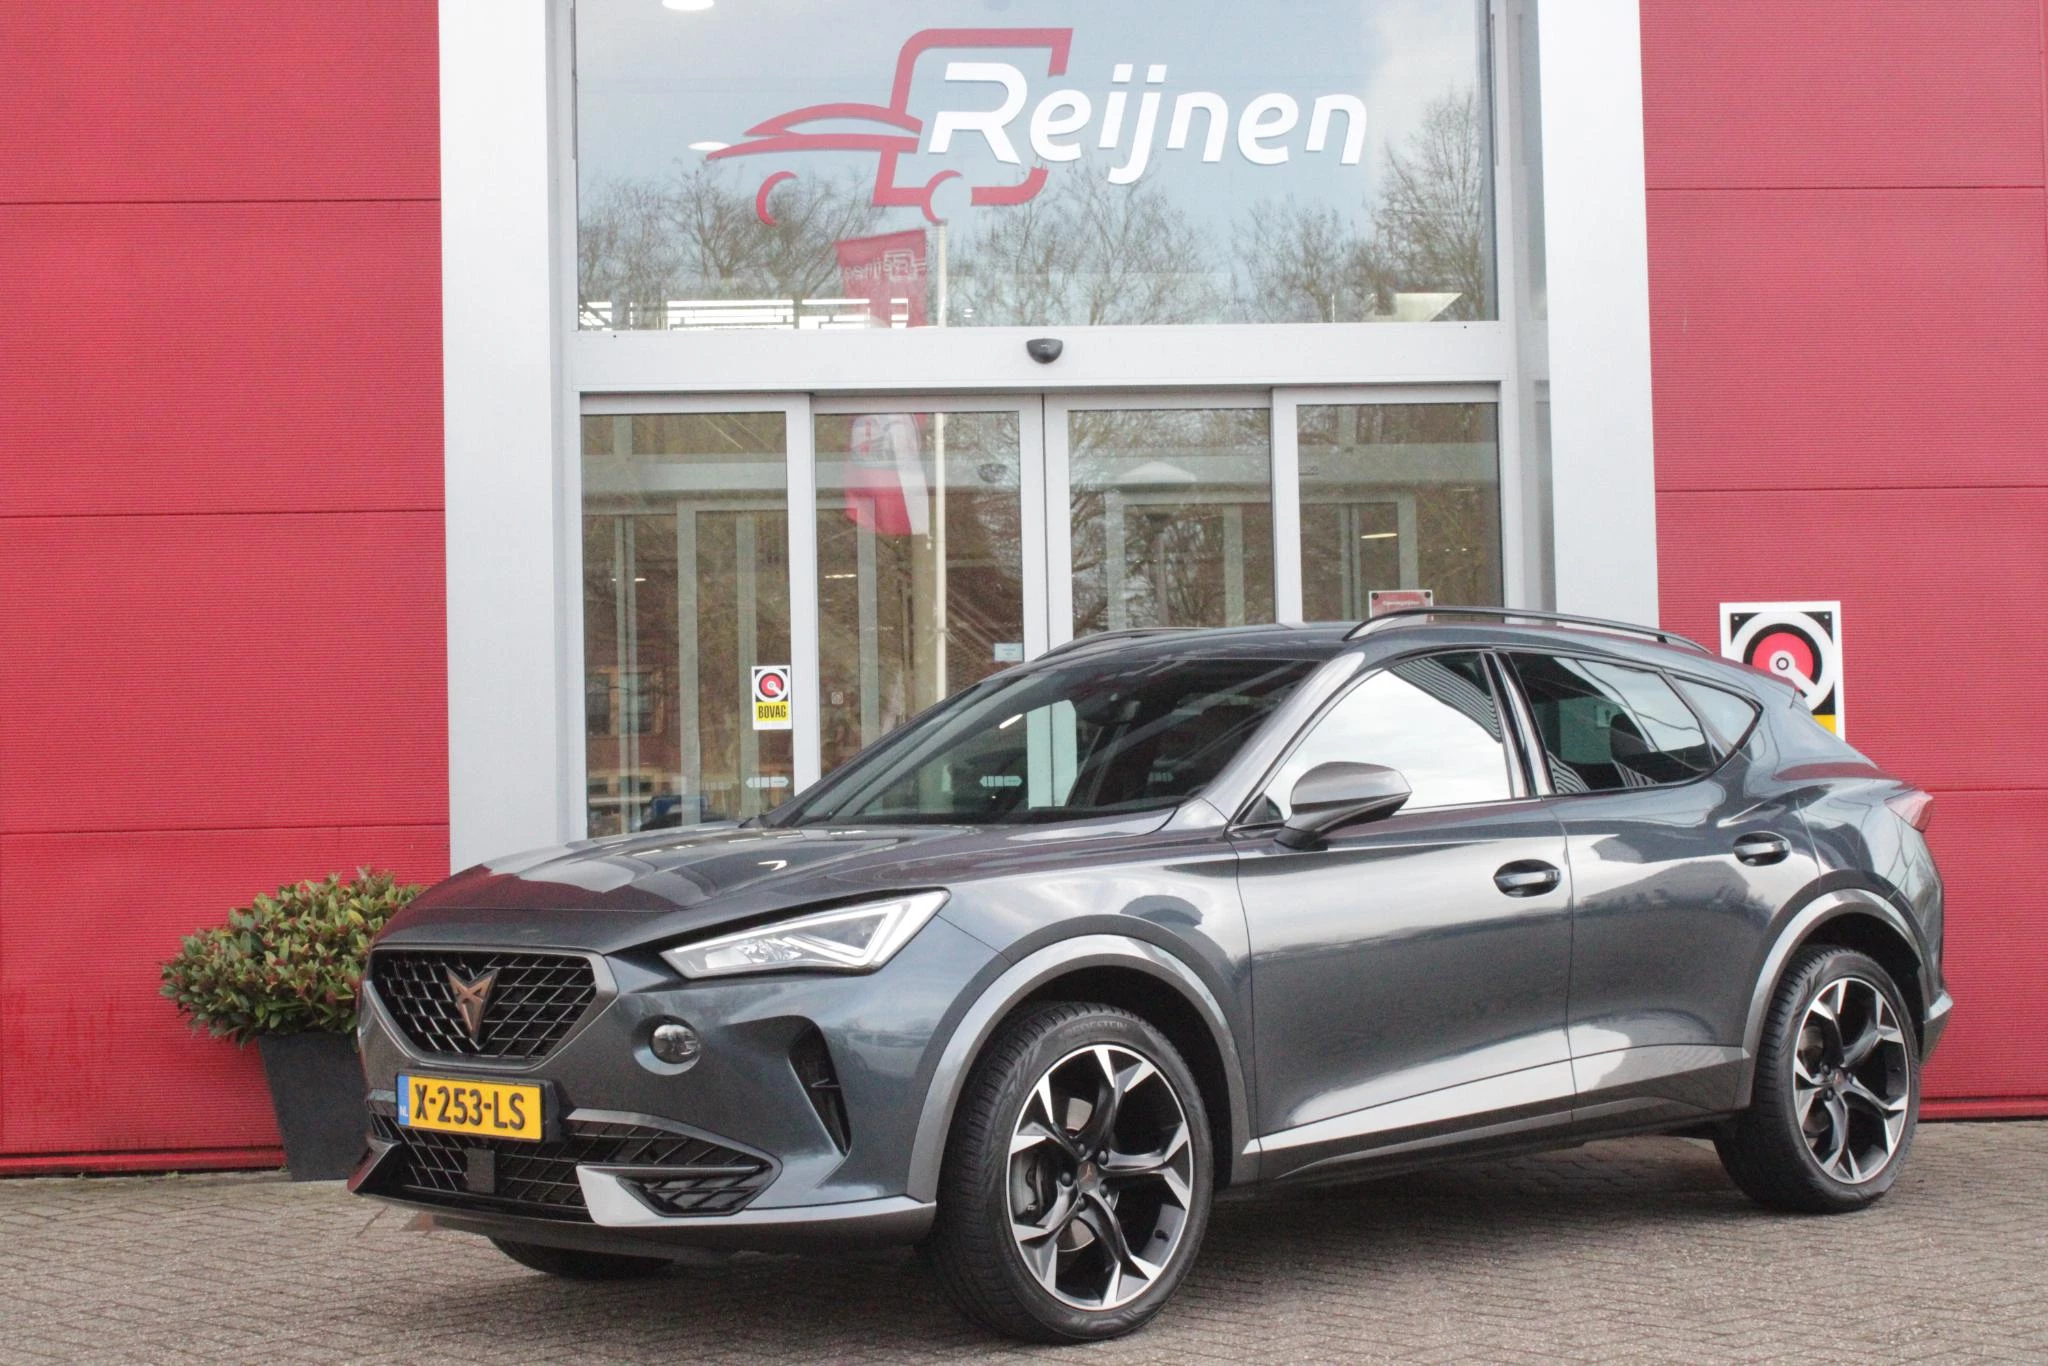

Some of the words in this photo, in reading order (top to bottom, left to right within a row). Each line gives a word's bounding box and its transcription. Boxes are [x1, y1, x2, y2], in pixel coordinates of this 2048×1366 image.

[929, 62, 1367, 185] Reijnen
[758, 705, 787, 718] BOVAG
[415, 1084, 526, 1130] X-253-LS
